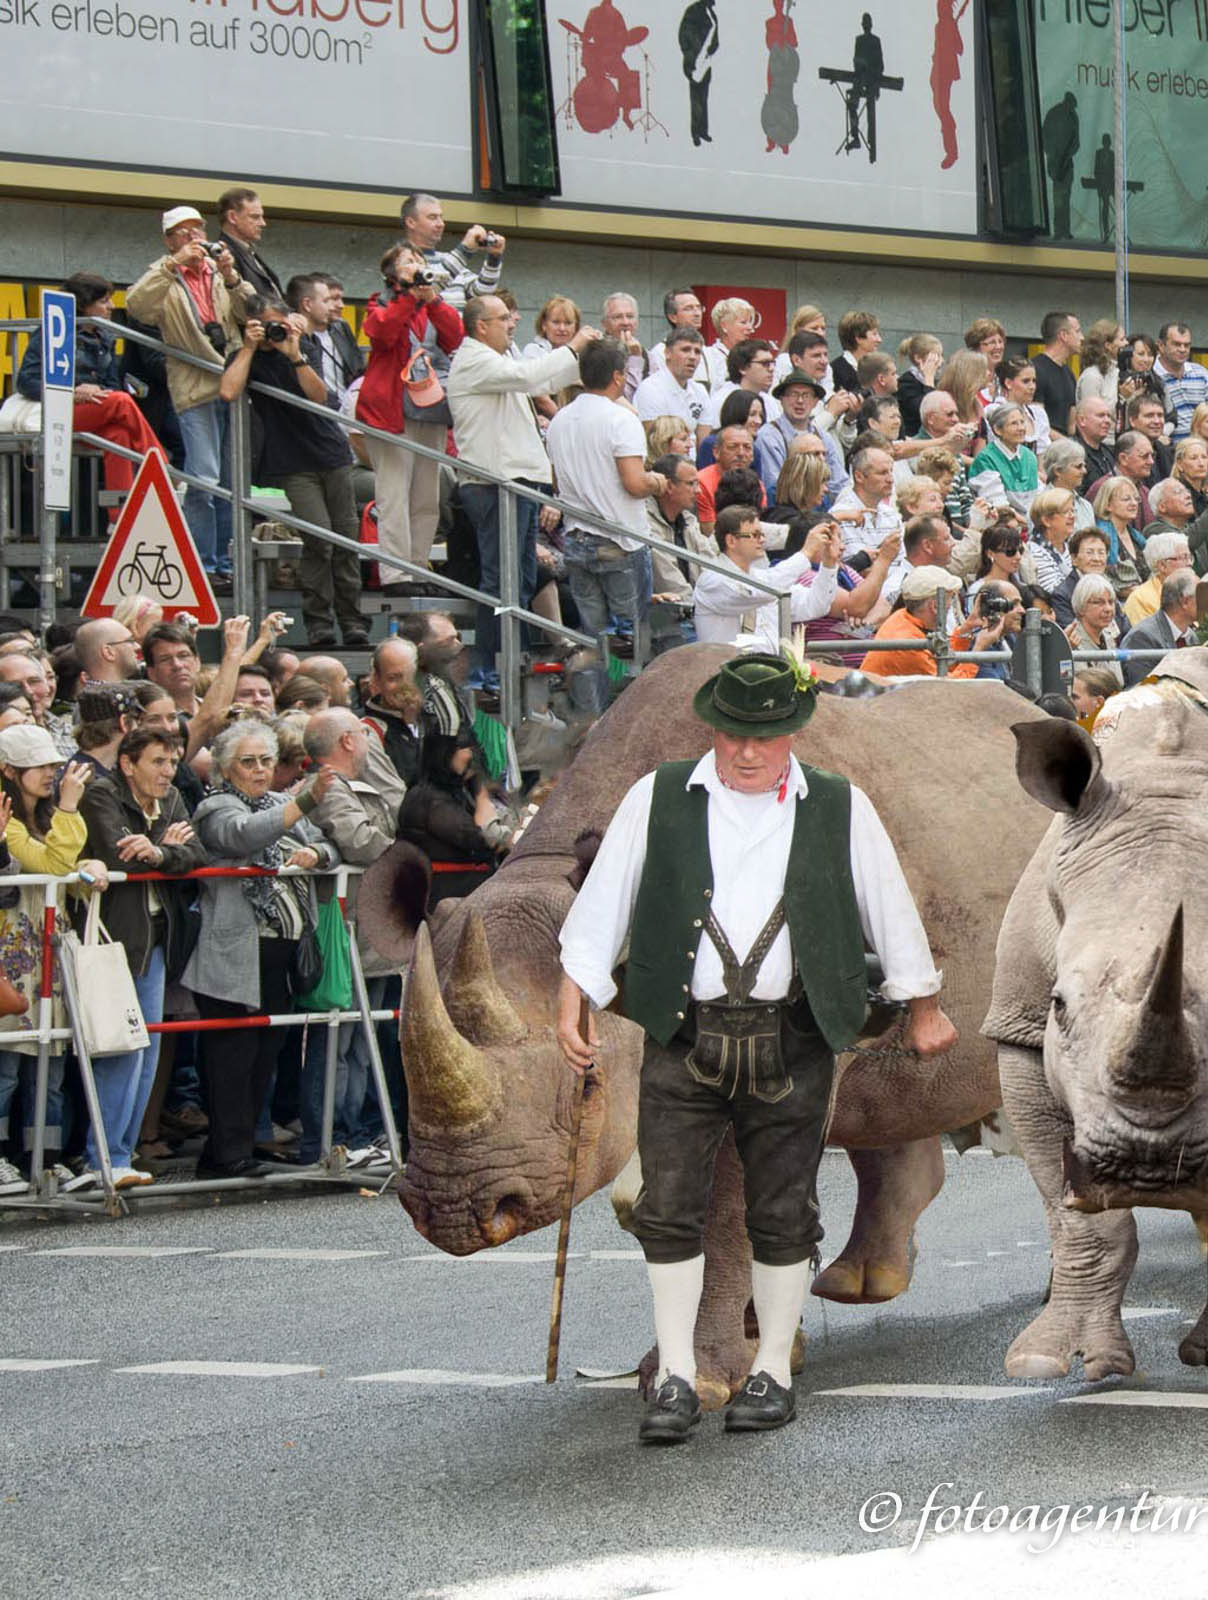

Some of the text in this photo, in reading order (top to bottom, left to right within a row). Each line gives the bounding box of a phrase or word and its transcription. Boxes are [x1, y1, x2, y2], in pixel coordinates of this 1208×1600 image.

[51, 1, 179, 43] erleben
[189, 18, 240, 50] auf
[1076, 62, 1141, 92] muk
[48, 303, 66, 375] P
